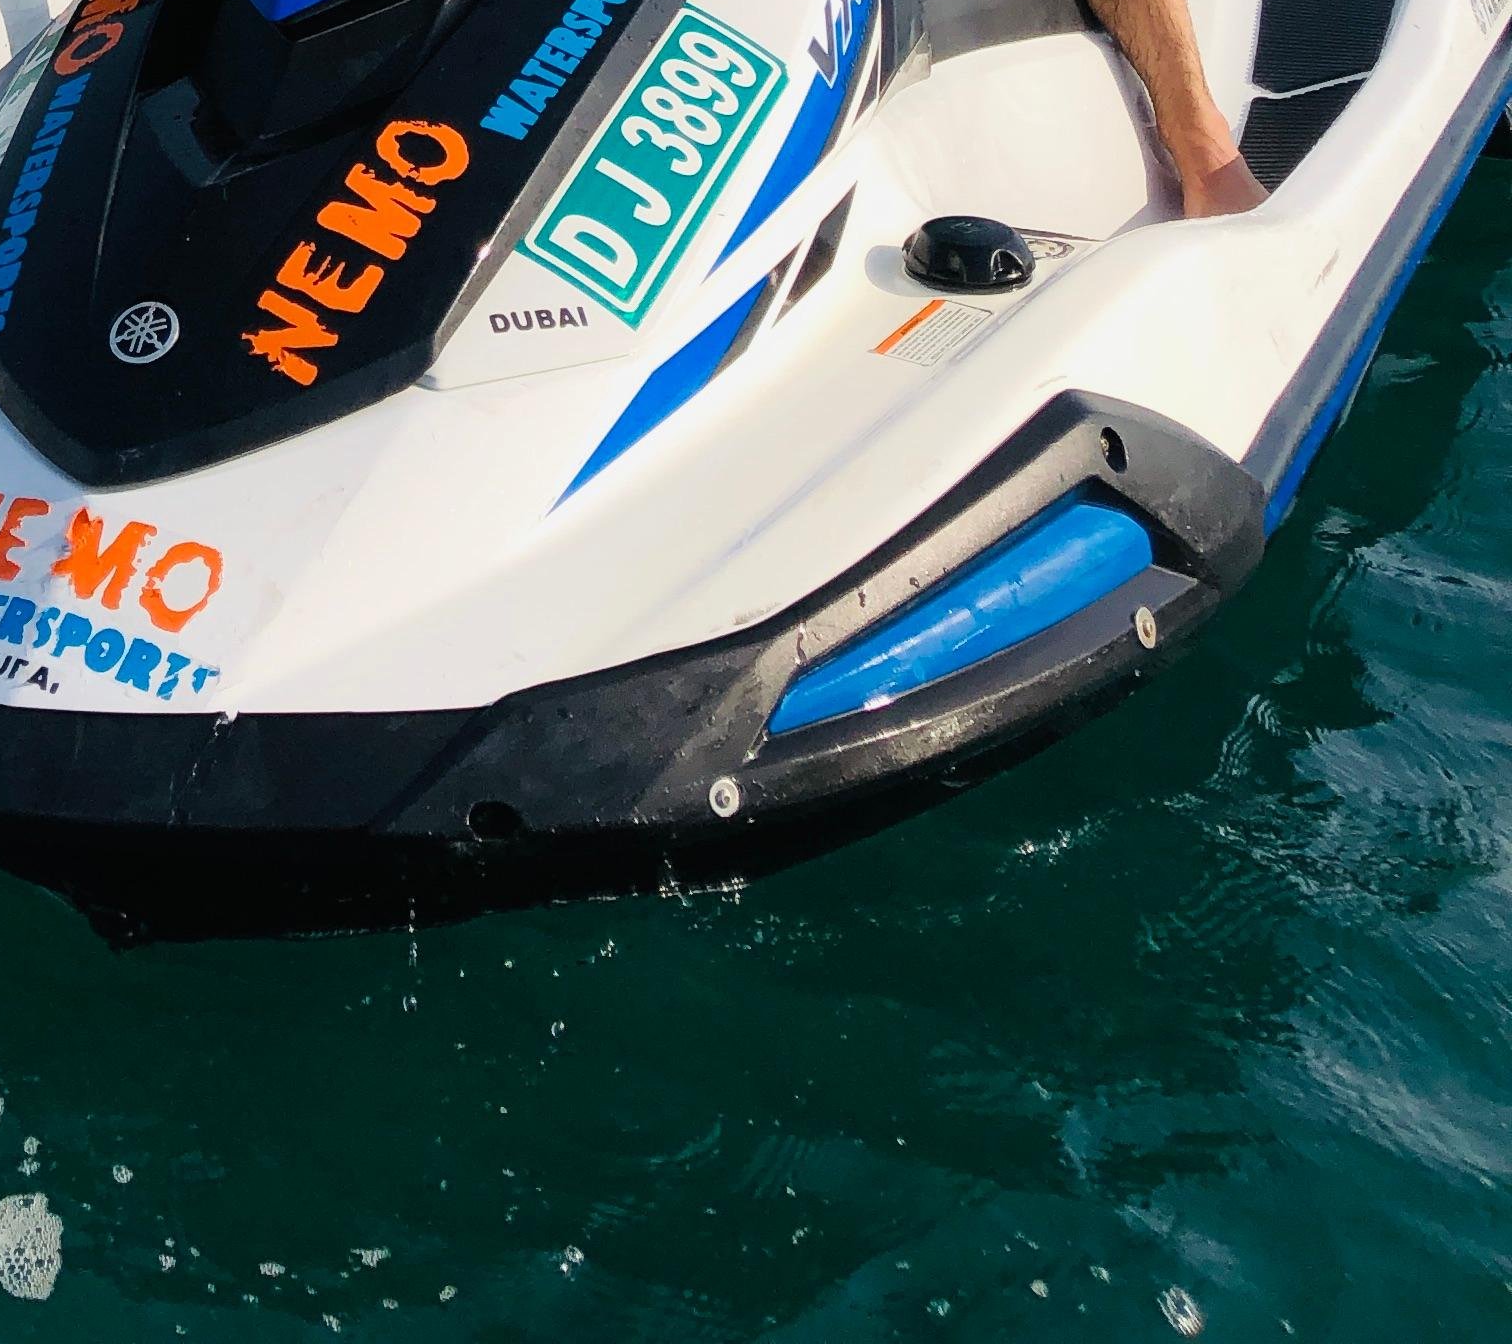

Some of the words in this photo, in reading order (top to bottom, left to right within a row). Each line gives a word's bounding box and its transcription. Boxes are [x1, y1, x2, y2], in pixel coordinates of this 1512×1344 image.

[620, 31, 758, 178] 3899
[594, 157, 673, 227] J
[241, 119, 470, 387] NEMO
[549, 214, 640, 290] D
[489, 305, 589, 335] DUBAI
